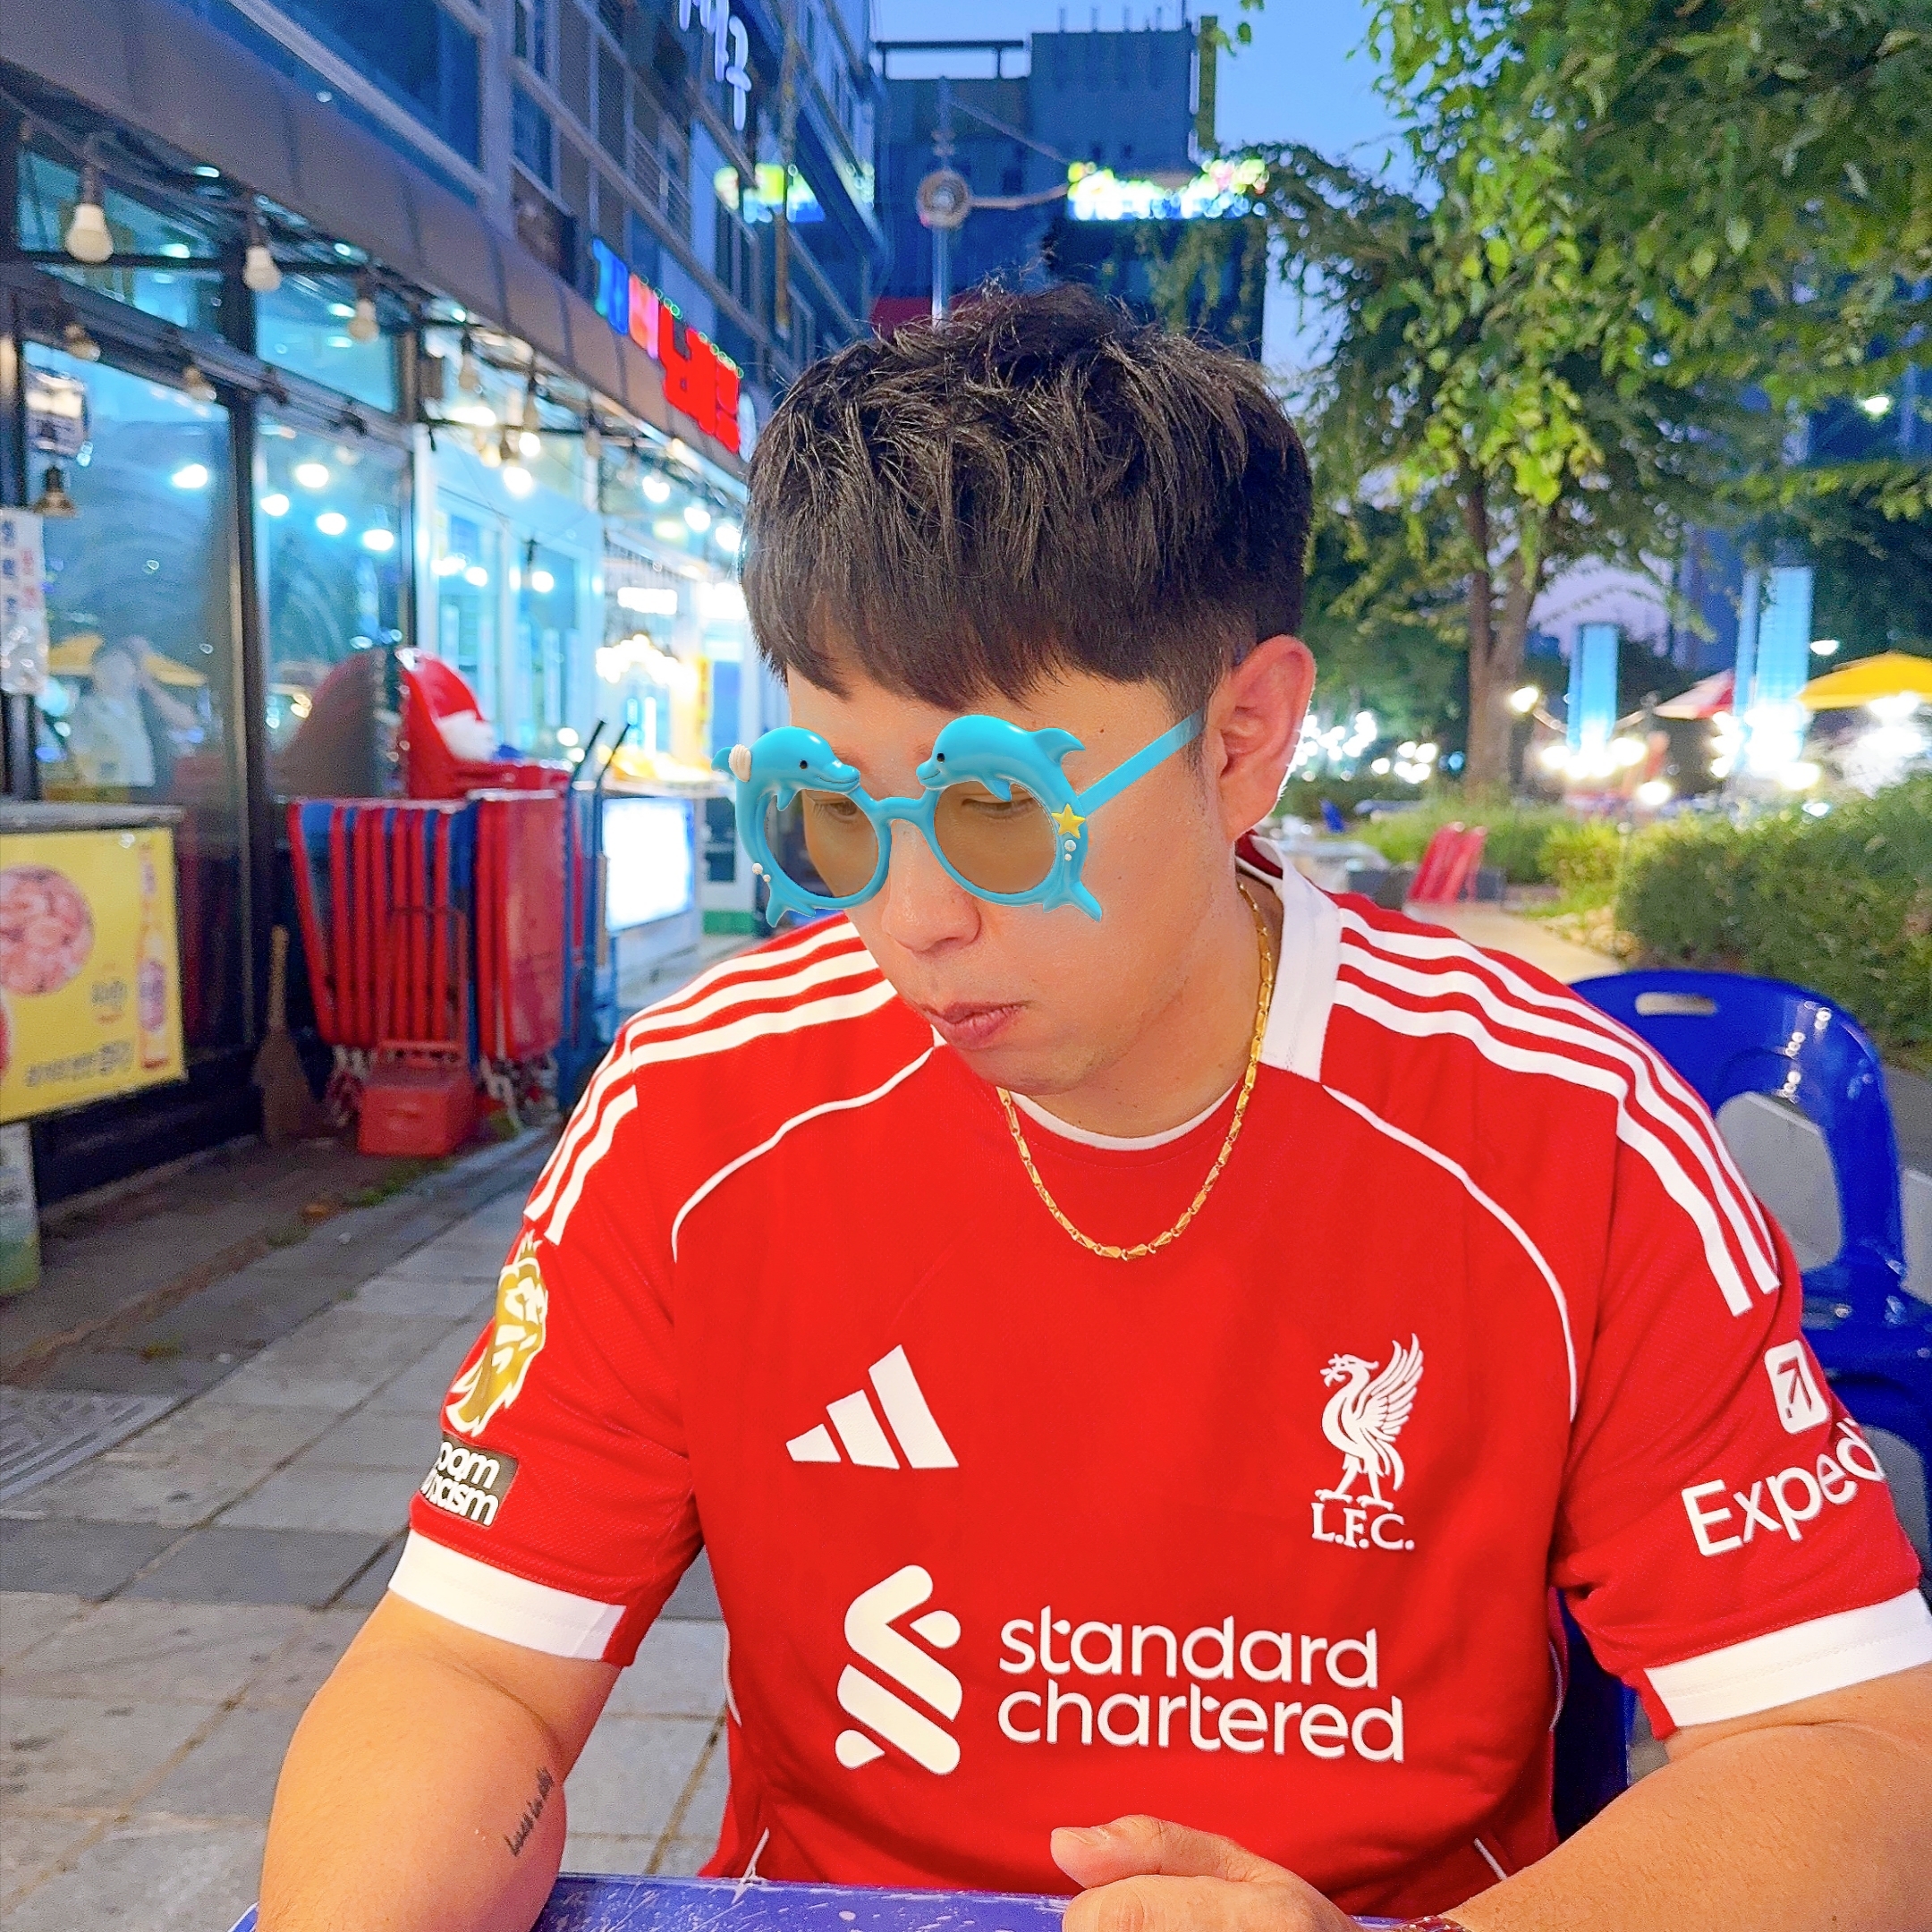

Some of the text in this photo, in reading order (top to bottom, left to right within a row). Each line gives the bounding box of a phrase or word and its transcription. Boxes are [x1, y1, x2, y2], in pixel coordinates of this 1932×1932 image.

[436, 1441, 501, 1489] oom
[1681, 1418, 1885, 1557] Exped
[1310, 1502, 1415, 1550] L.F.C.
[999, 1606, 1378, 1690] standard
[997, 1678, 1405, 1764] chartered
